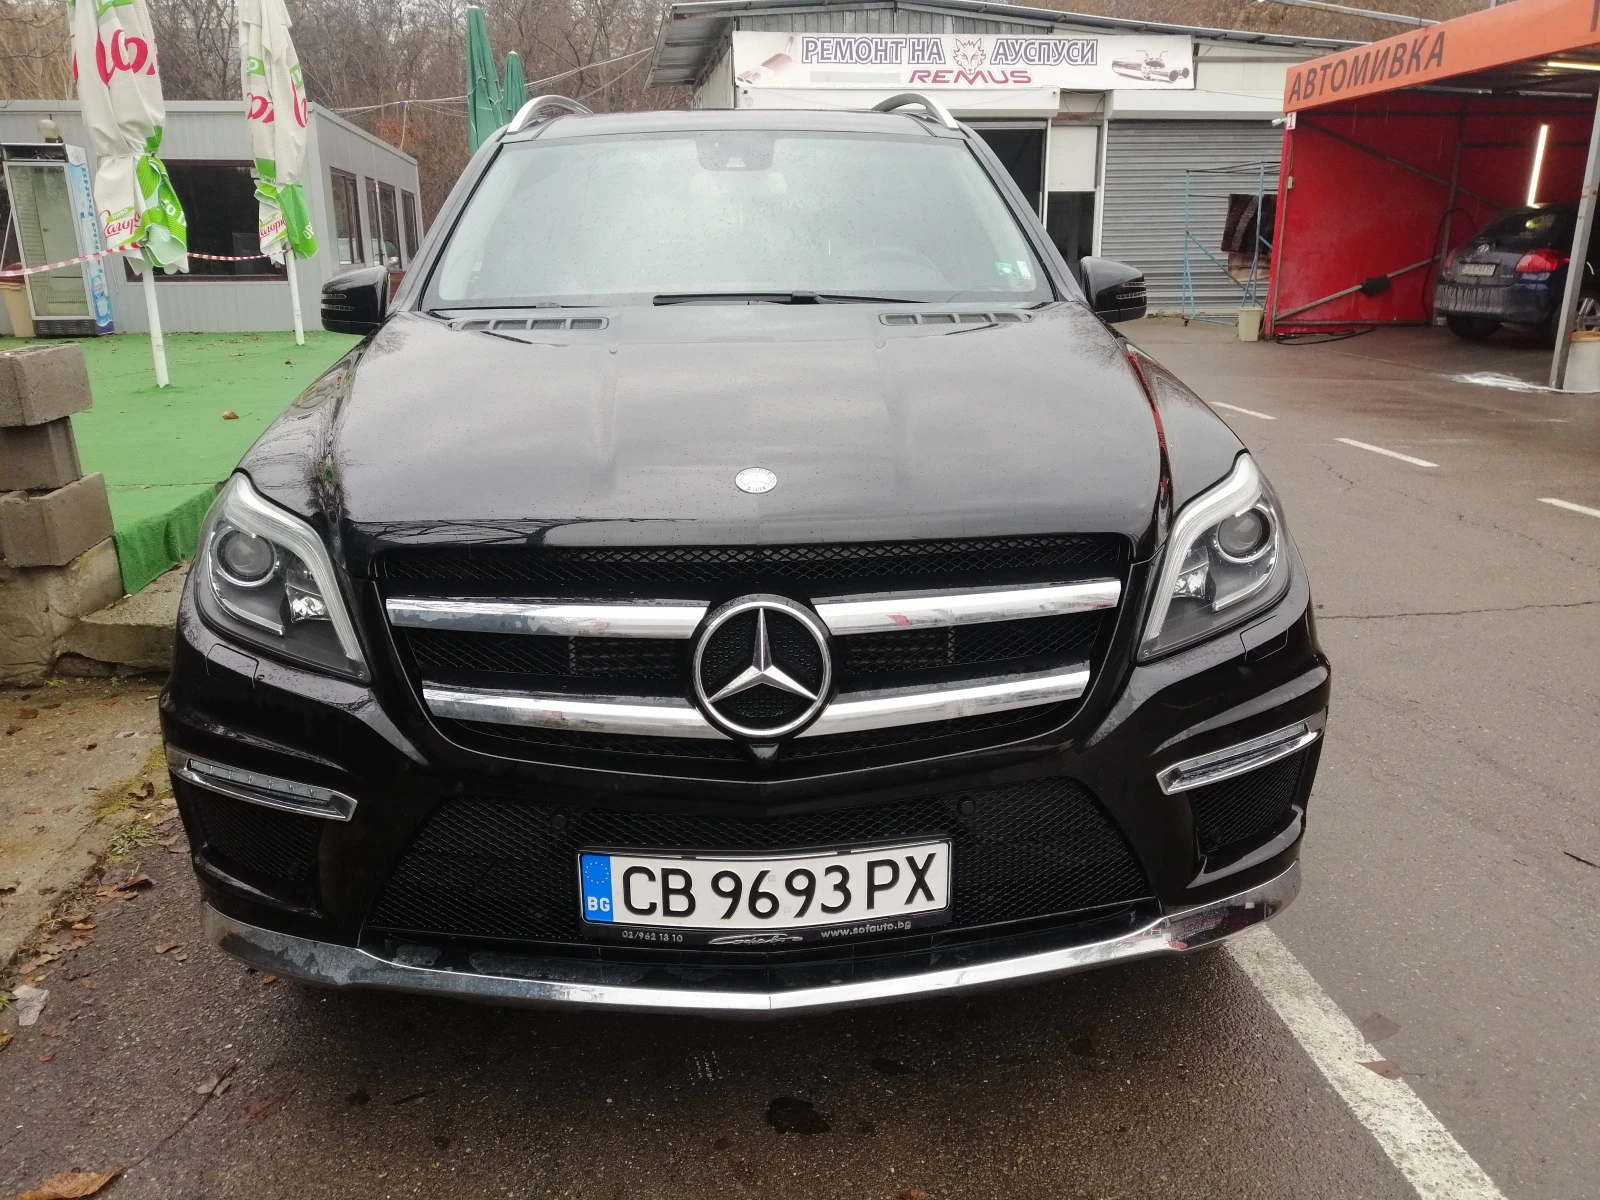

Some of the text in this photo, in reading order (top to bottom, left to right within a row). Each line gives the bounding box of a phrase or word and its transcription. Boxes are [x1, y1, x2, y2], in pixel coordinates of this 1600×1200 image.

[802, 37, 1099, 66] РЕМОНТ НА АУСПУСИ
[908, 69, 1032, 86] REMUS
[1288, 31, 1445, 105] АВТОМИВКА
[622, 852, 937, 920] CB 9693 PX
[587, 896, 611, 912] BG
[820, 920, 912, 938] www.sofauto.bg
